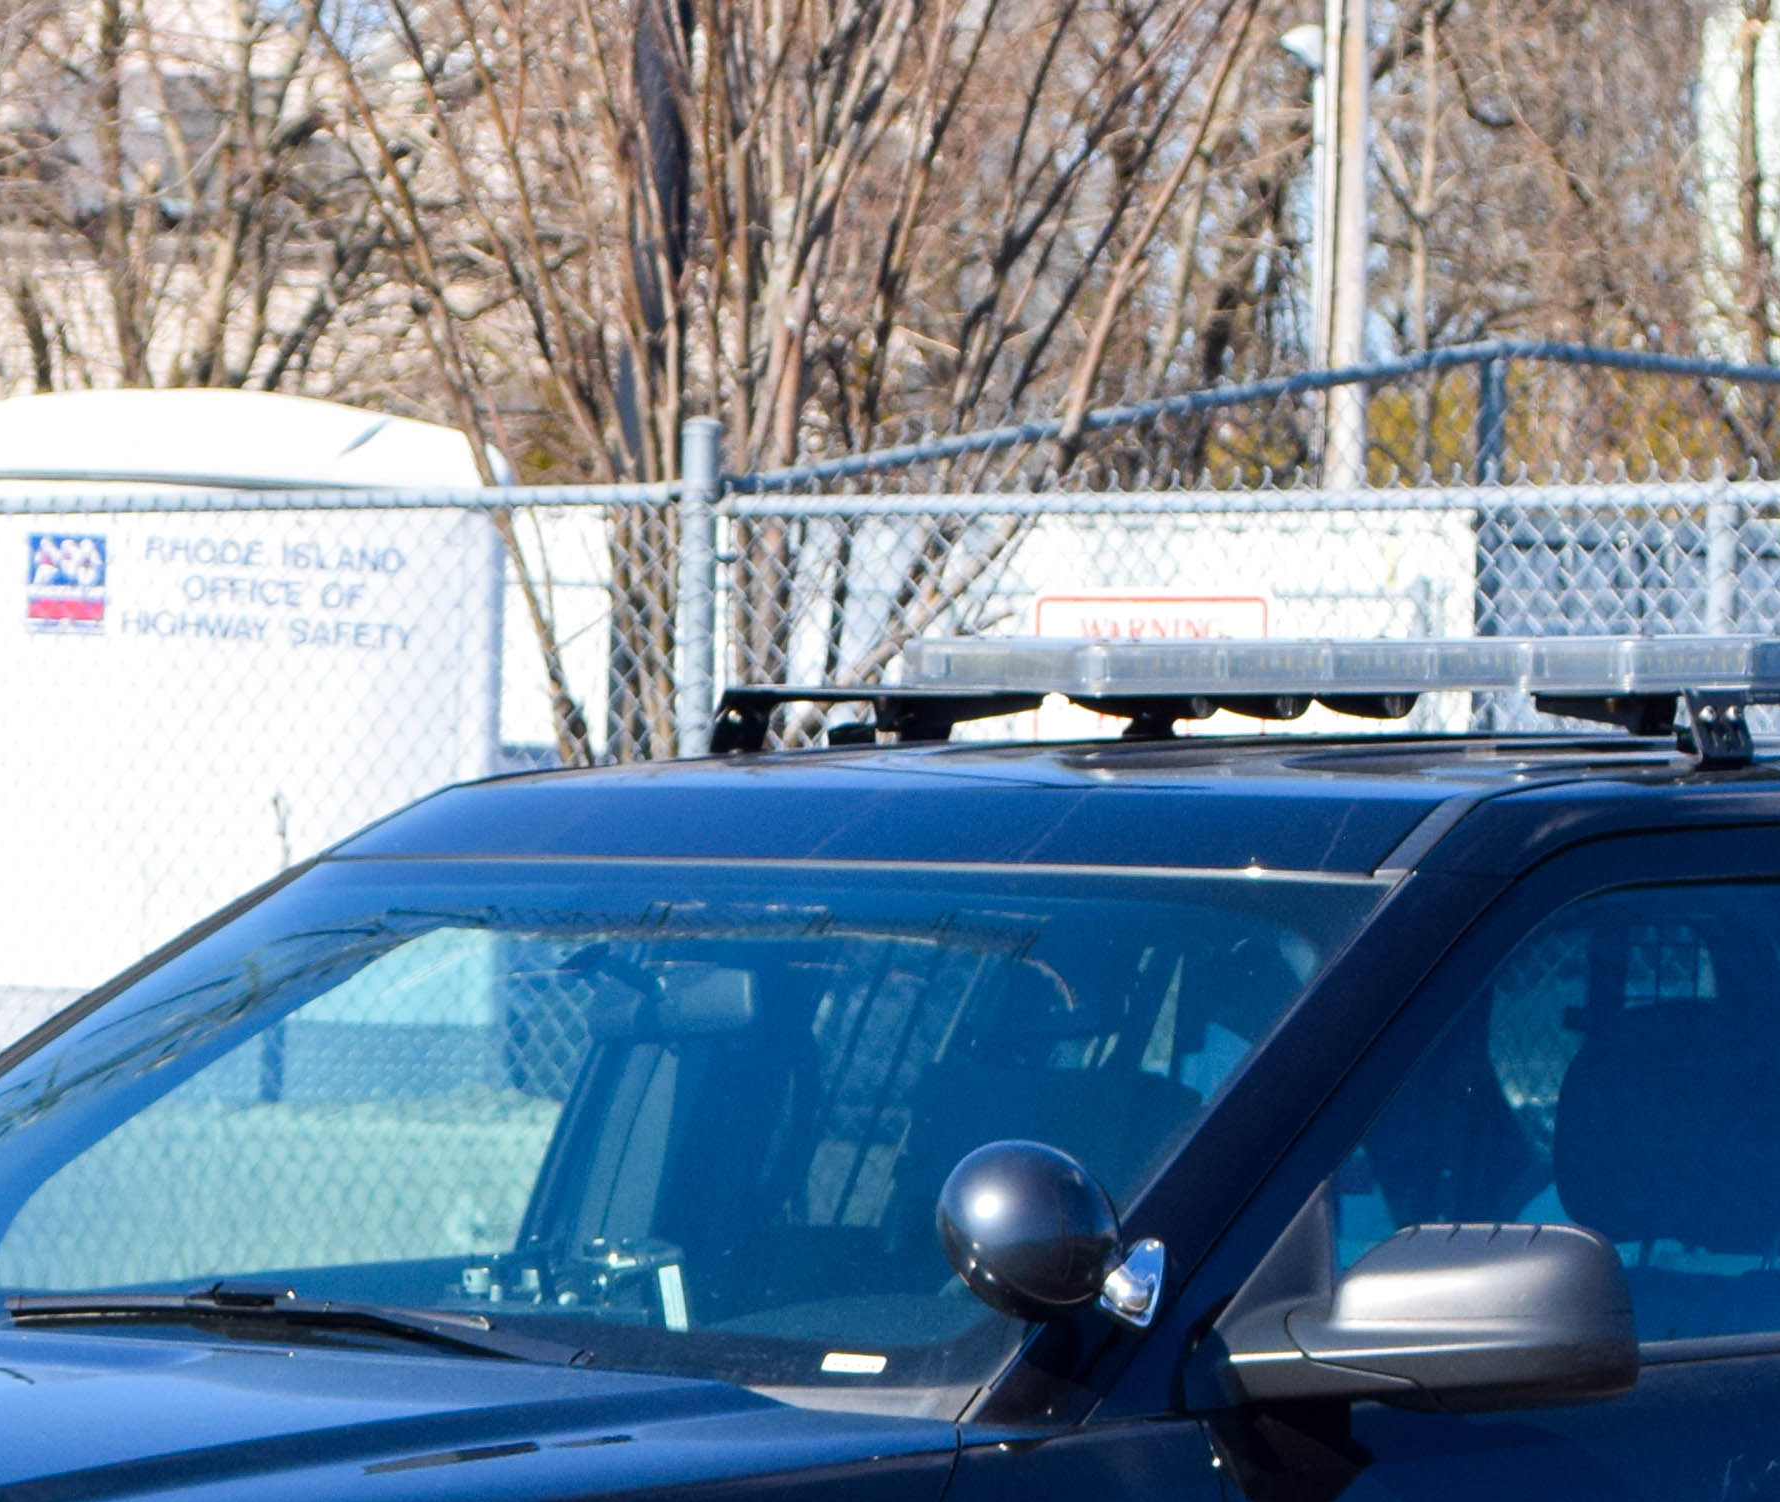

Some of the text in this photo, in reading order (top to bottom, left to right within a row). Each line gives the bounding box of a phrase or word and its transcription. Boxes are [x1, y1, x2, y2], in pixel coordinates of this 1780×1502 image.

[145, 536, 406, 575] RHODE ISLAND
[181, 574, 366, 609] OFFICE OF
[120, 610, 421, 651] HIGHWAY SAFETY
